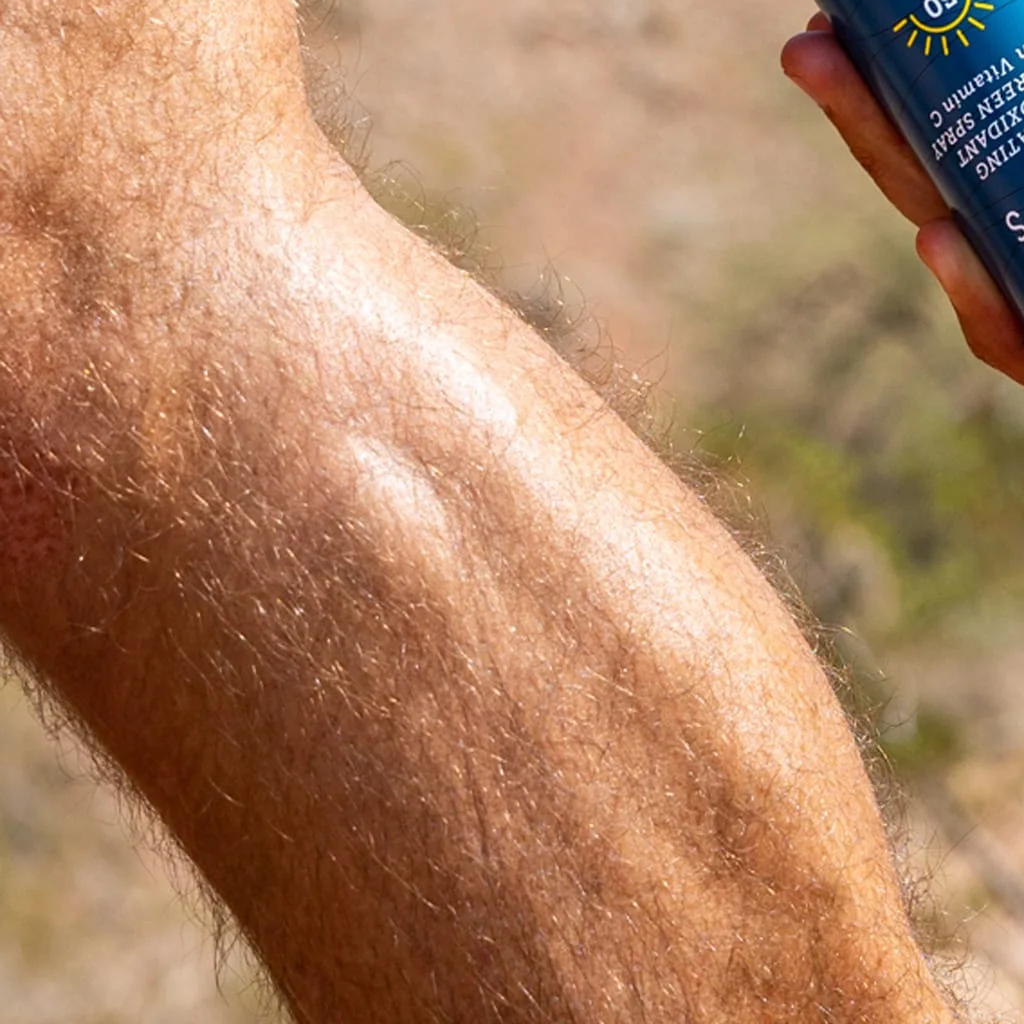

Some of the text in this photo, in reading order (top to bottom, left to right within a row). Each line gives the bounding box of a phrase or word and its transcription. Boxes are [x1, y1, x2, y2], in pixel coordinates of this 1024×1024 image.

[944, 57, 1015, 114] Vitamin
[929, 109, 944, 128] C
[930, 112, 976, 161] SPRAY
